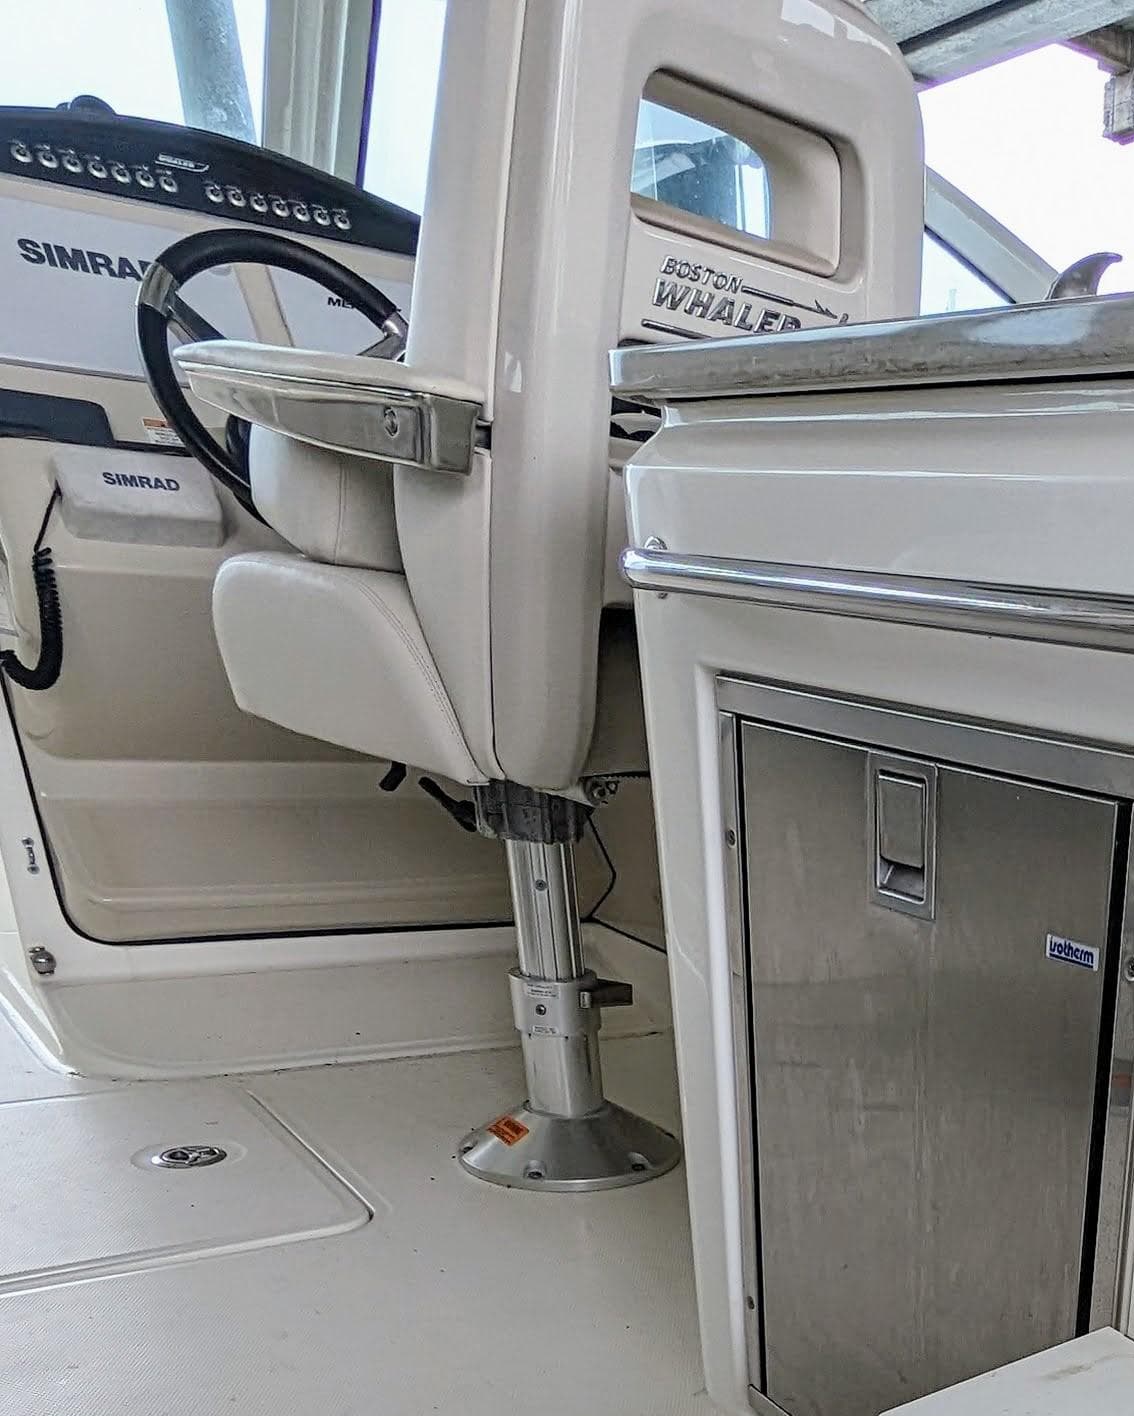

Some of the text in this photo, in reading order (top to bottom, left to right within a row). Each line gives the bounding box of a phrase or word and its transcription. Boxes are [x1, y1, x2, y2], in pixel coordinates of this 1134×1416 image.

[660, 256, 743, 295] BOSTON
[652, 278, 802, 333] WHALER
[102, 471, 181, 491] SIMRAD
